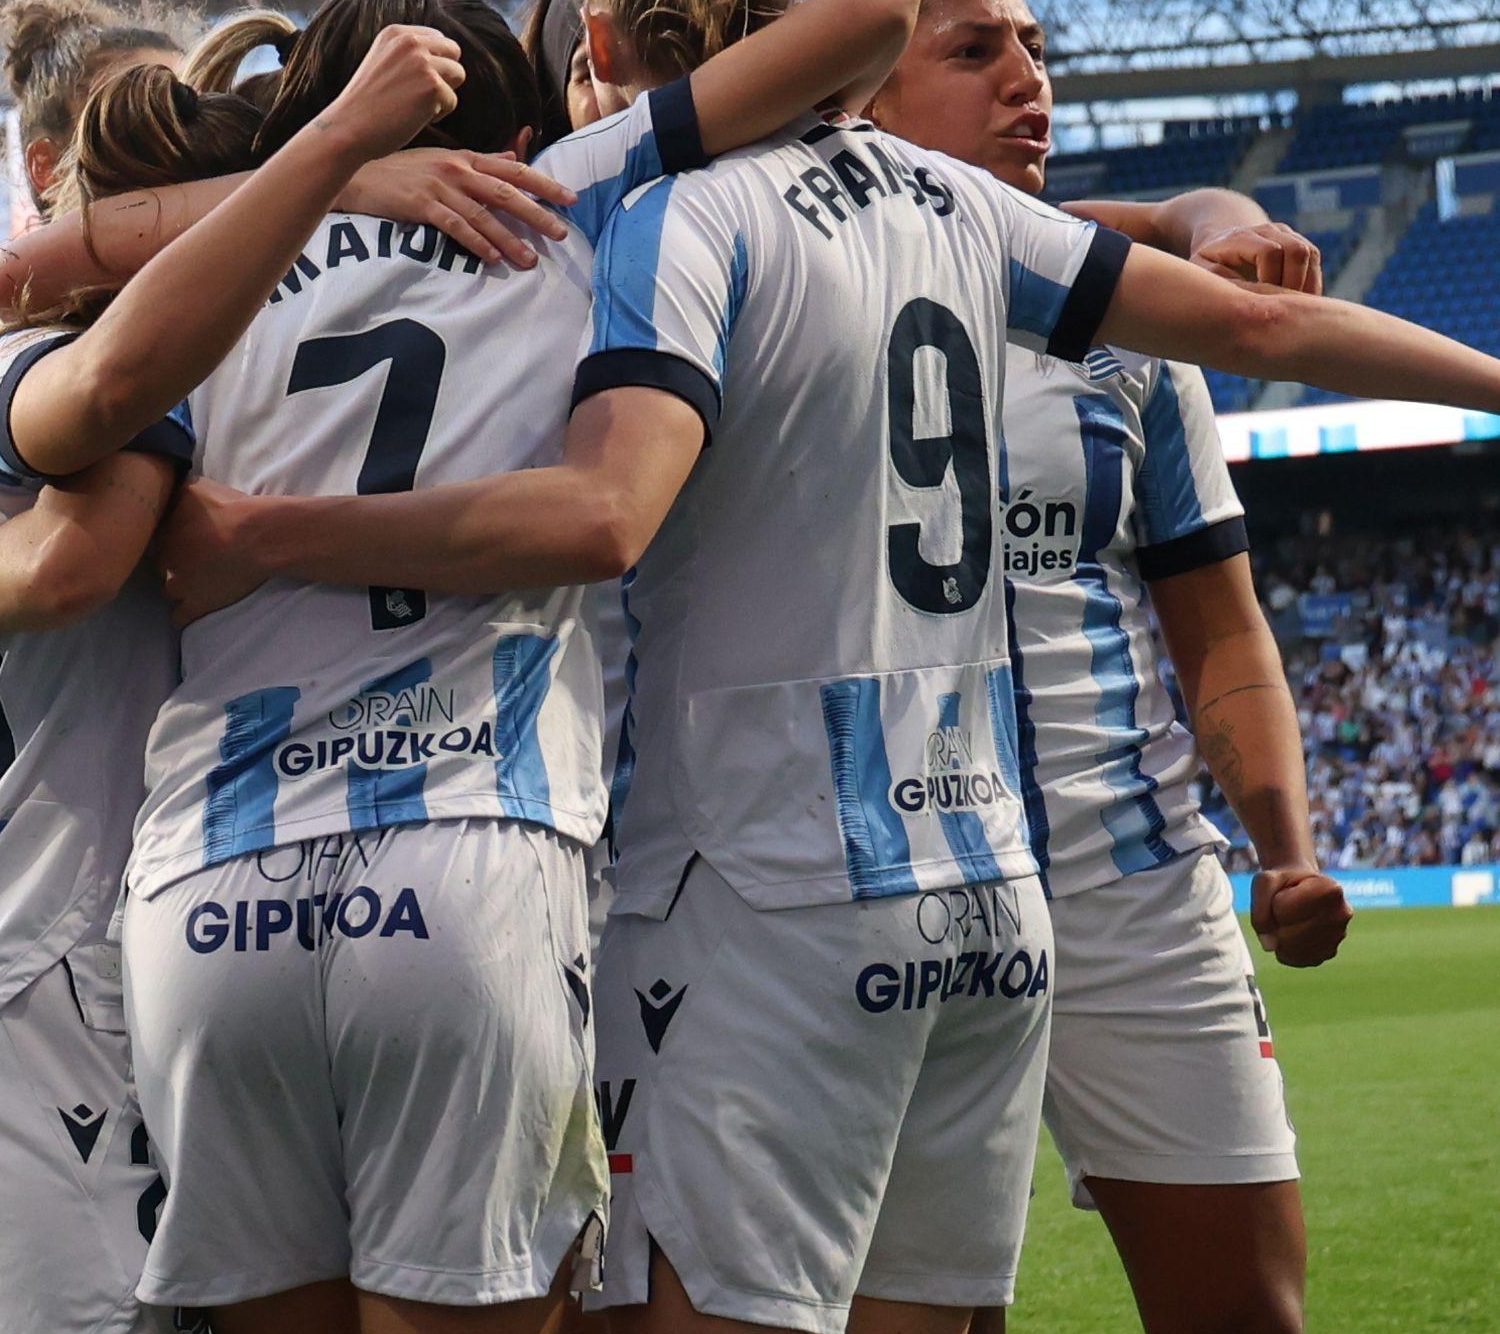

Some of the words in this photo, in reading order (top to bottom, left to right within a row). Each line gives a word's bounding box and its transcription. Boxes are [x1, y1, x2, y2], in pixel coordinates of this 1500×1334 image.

[286, 318, 447, 630] 7
[887, 297, 992, 614] 9
[1003, 542, 1072, 576] iajes
[329, 685, 455, 731] ORAIN
[278, 721, 498, 777] GIPUZKOA
[893, 771, 1010, 813] GPUZKOA
[594, 1078, 637, 1151] V
